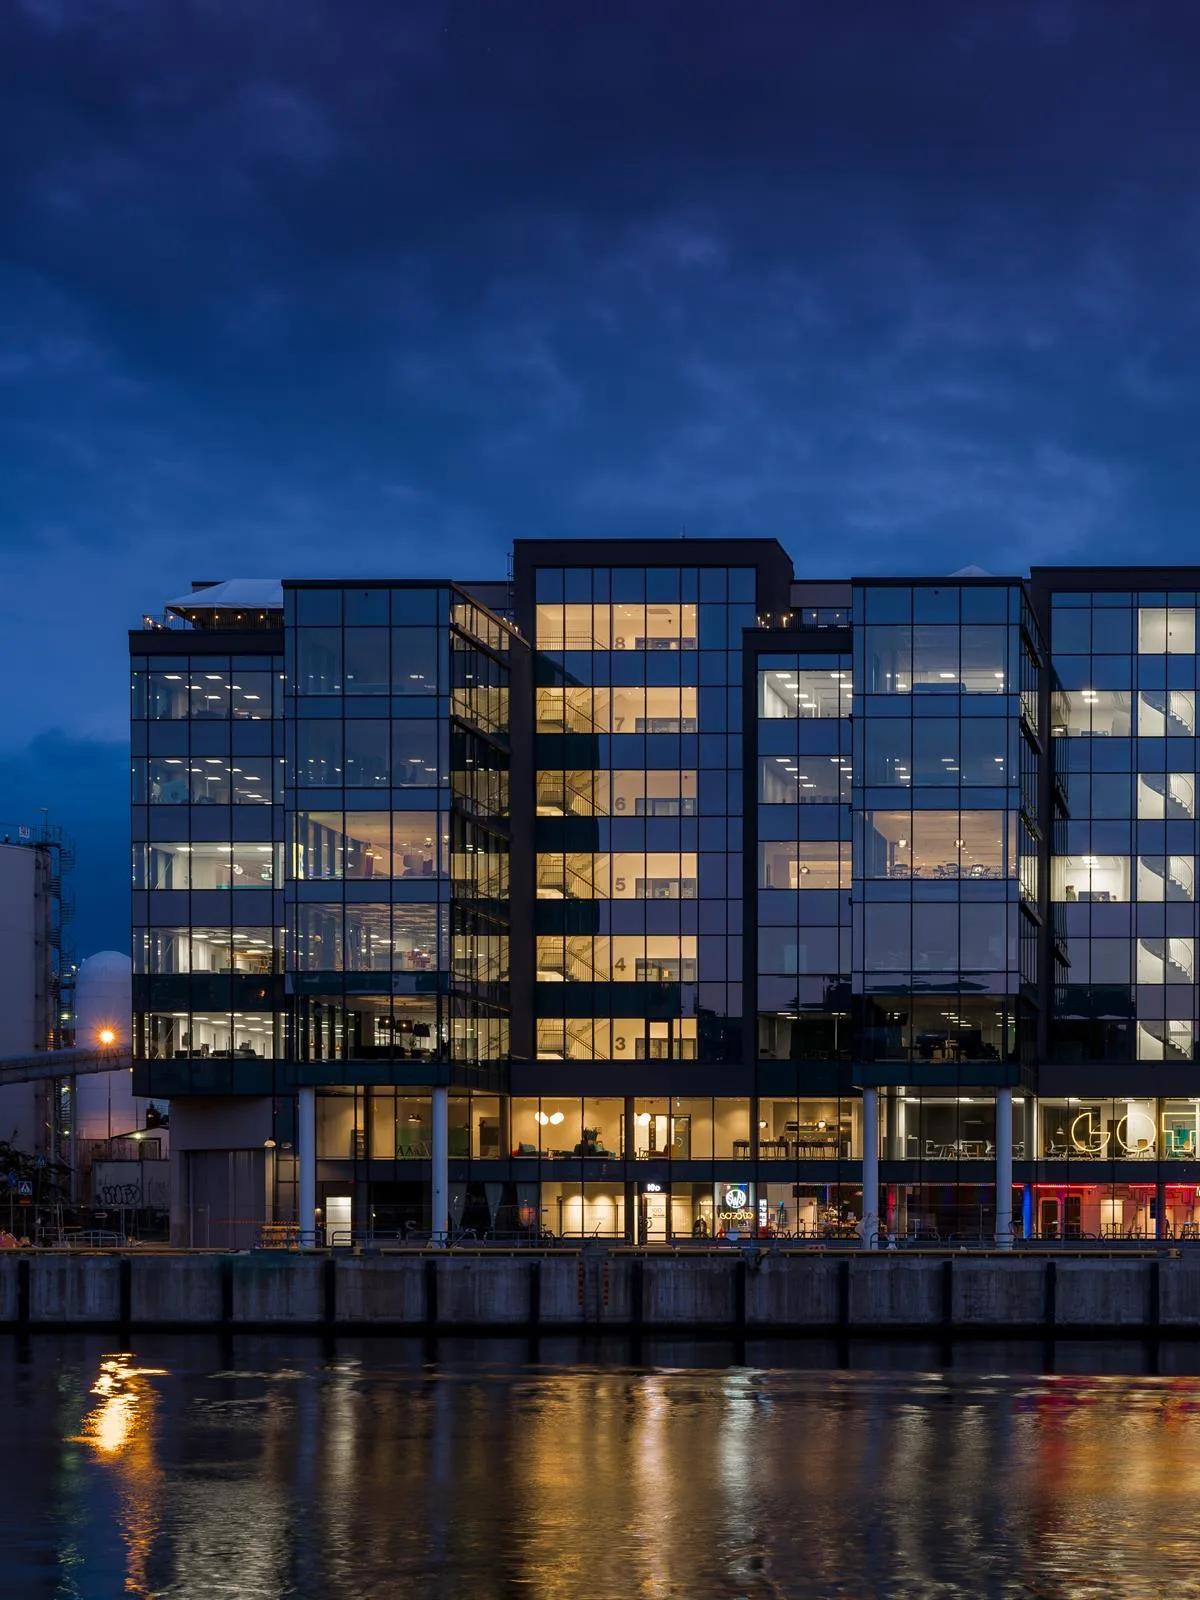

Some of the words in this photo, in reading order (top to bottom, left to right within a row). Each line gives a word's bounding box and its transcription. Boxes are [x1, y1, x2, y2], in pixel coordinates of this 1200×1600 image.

[615, 636, 626, 649] 8
[614, 716, 625, 730] 7
[615, 797, 626, 811] 6
[615, 877, 626, 892] 5
[614, 957, 626, 971] 4
[615, 1037, 626, 1051] 3
